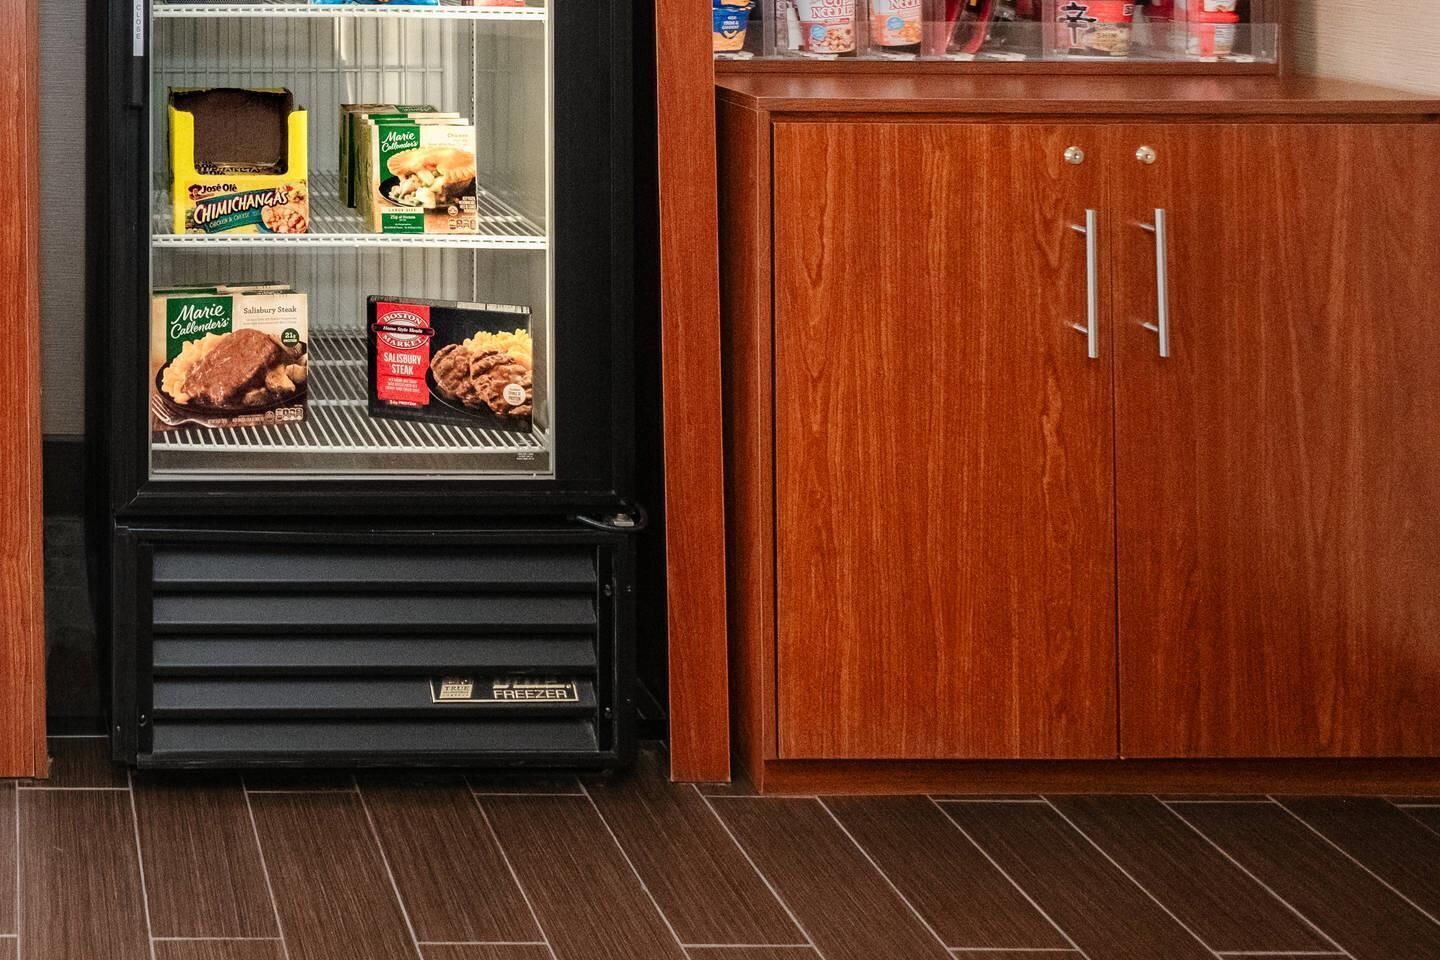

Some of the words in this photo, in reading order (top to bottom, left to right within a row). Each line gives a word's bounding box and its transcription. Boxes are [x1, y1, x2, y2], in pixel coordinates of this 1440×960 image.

[382, 131, 416, 144] Marie
[201, 184, 221, 193] José
[222, 183, 238, 192] Olé
[193, 190, 289, 224] CHIMICHANGAS
[171, 303, 225, 325] Marie
[243, 306, 277, 315] Salisbury
[277, 305, 297, 313] Steak
[383, 312, 422, 325] BOSTON
[171, 317, 230, 339] Callender's
[382, 334, 422, 347] MARKET
[383, 351, 422, 365] SALISBURY
[391, 363, 414, 375] STEAK
[493, 689, 568, 699] FREEZER
